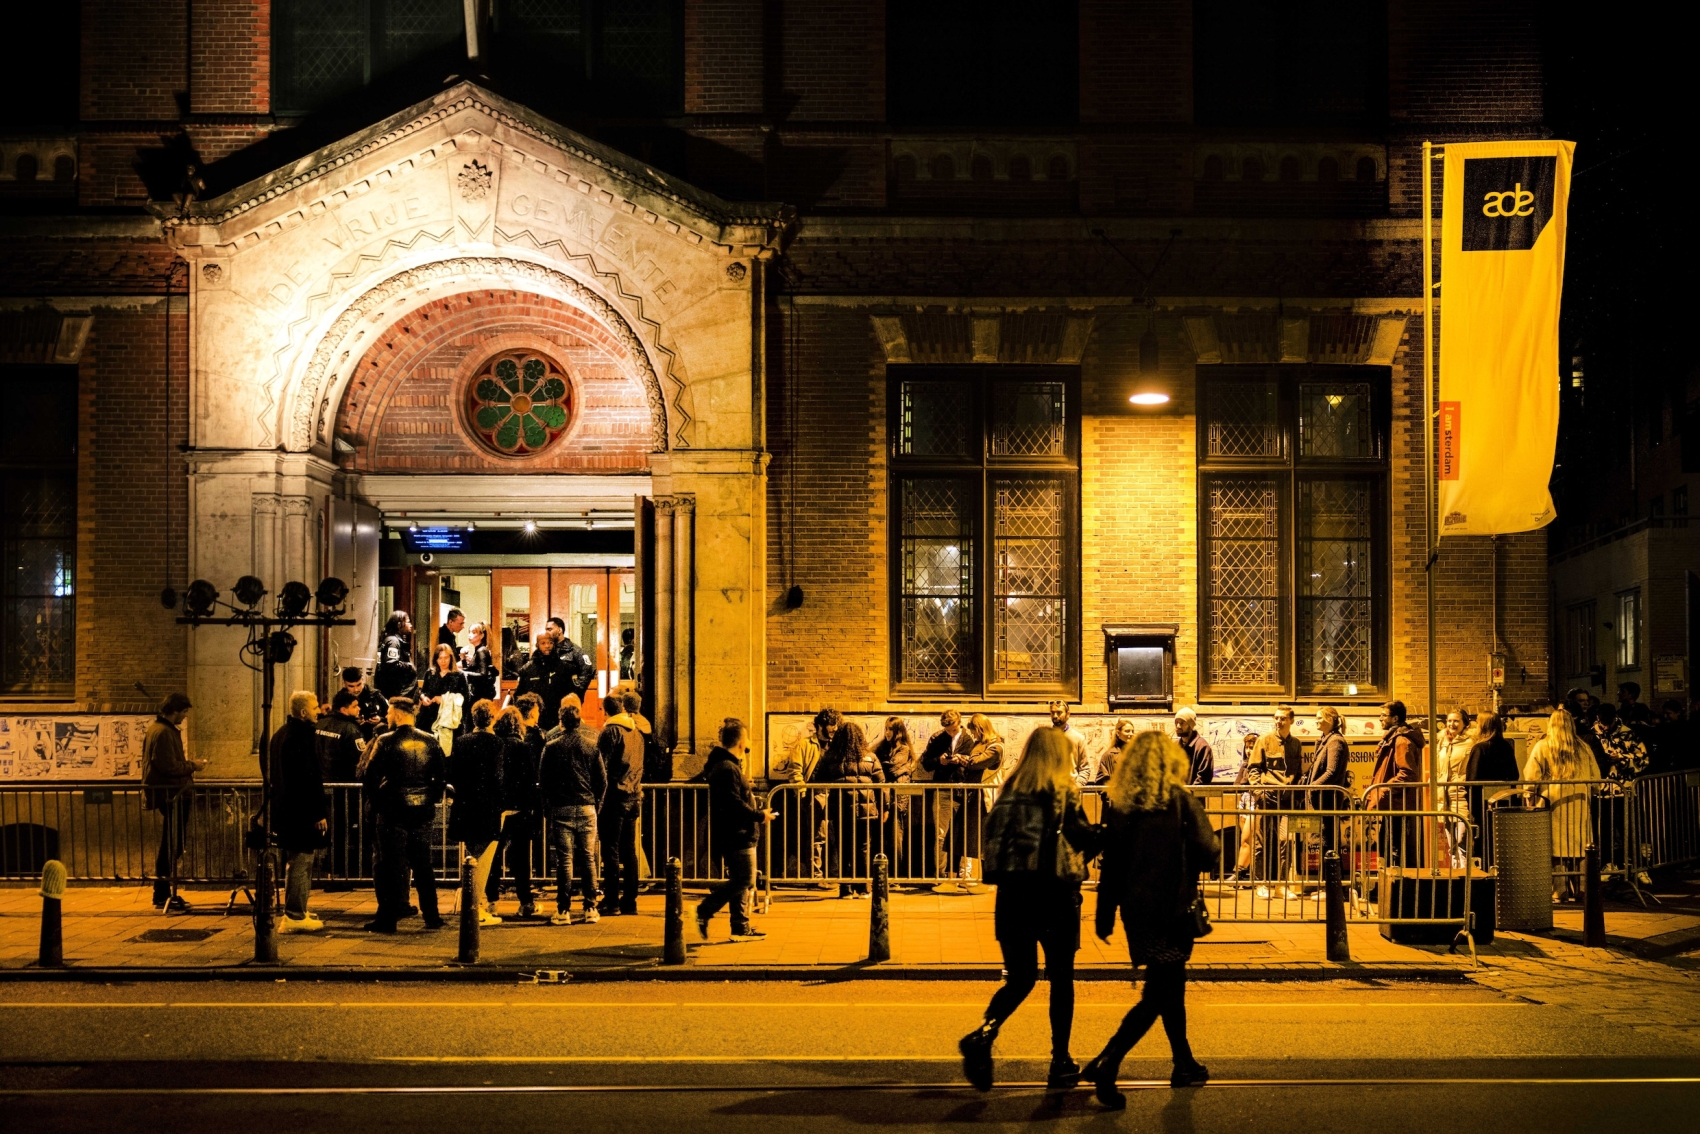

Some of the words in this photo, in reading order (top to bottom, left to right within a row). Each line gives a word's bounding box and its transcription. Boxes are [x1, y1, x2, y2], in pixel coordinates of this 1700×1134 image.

[1482, 182, 1535, 218] ade
[268, 260, 312, 305] DE
[322, 197, 429, 250] VRIJE
[511, 194, 678, 305] GEMEENTE
[320, 730, 342, 740] SECURITY
